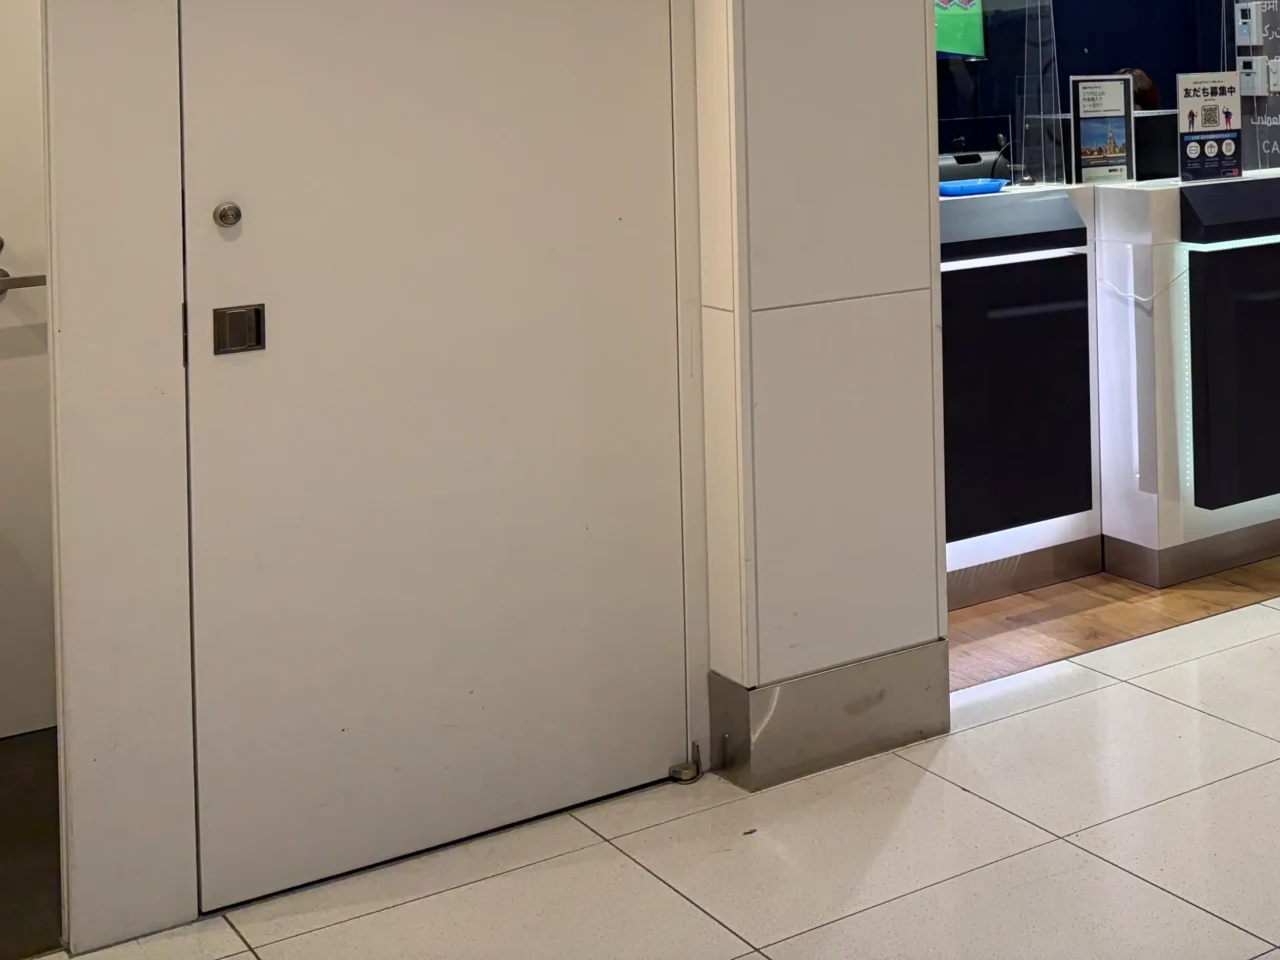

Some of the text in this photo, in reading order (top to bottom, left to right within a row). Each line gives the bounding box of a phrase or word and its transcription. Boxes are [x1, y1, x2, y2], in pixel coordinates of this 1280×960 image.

[1183, 85, 1236, 99] 友だち募集中
